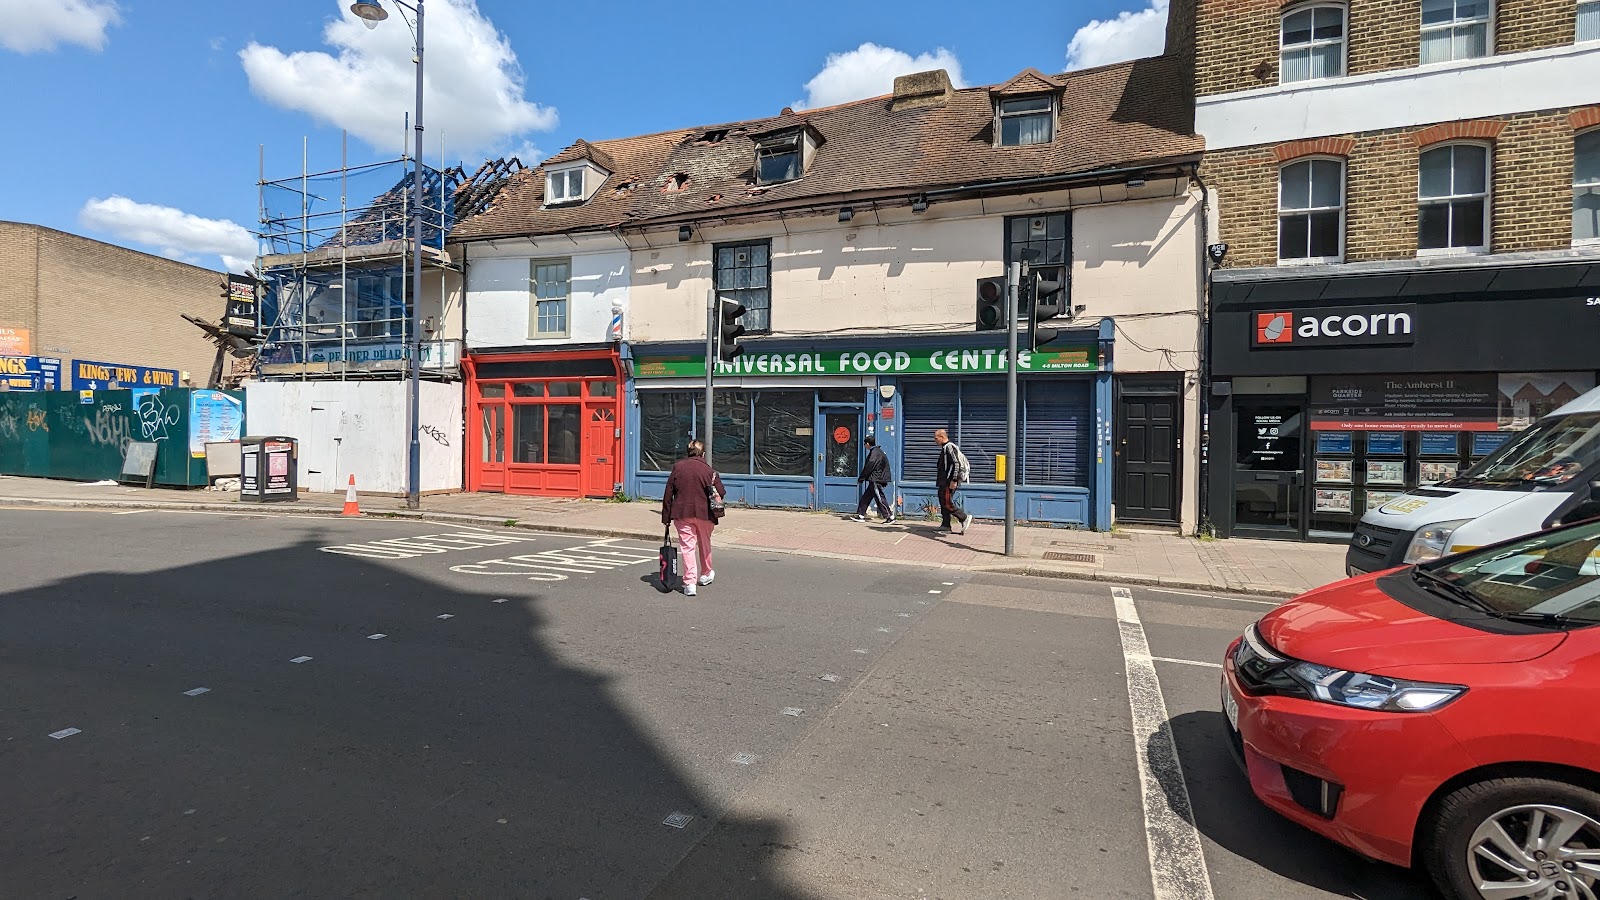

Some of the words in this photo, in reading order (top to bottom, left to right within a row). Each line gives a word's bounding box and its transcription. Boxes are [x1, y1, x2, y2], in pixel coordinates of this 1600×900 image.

[1586, 297, 1600, 305] SA
[1298, 312, 1411, 338] acorn
[374, 347, 432, 362] PHARMCY
[840, 352, 910, 372] FOOD
[930, 349, 1032, 370] CENTRE
[0, 358, 26, 374] NGS
[79, 364, 109, 380] KINGS
[116, 368, 137, 383] EWS
[143, 370, 151, 384] &
[152, 371, 173, 385] WINE
[317, 532, 536, 559] QUEEN
[449, 538, 674, 581] STREET
